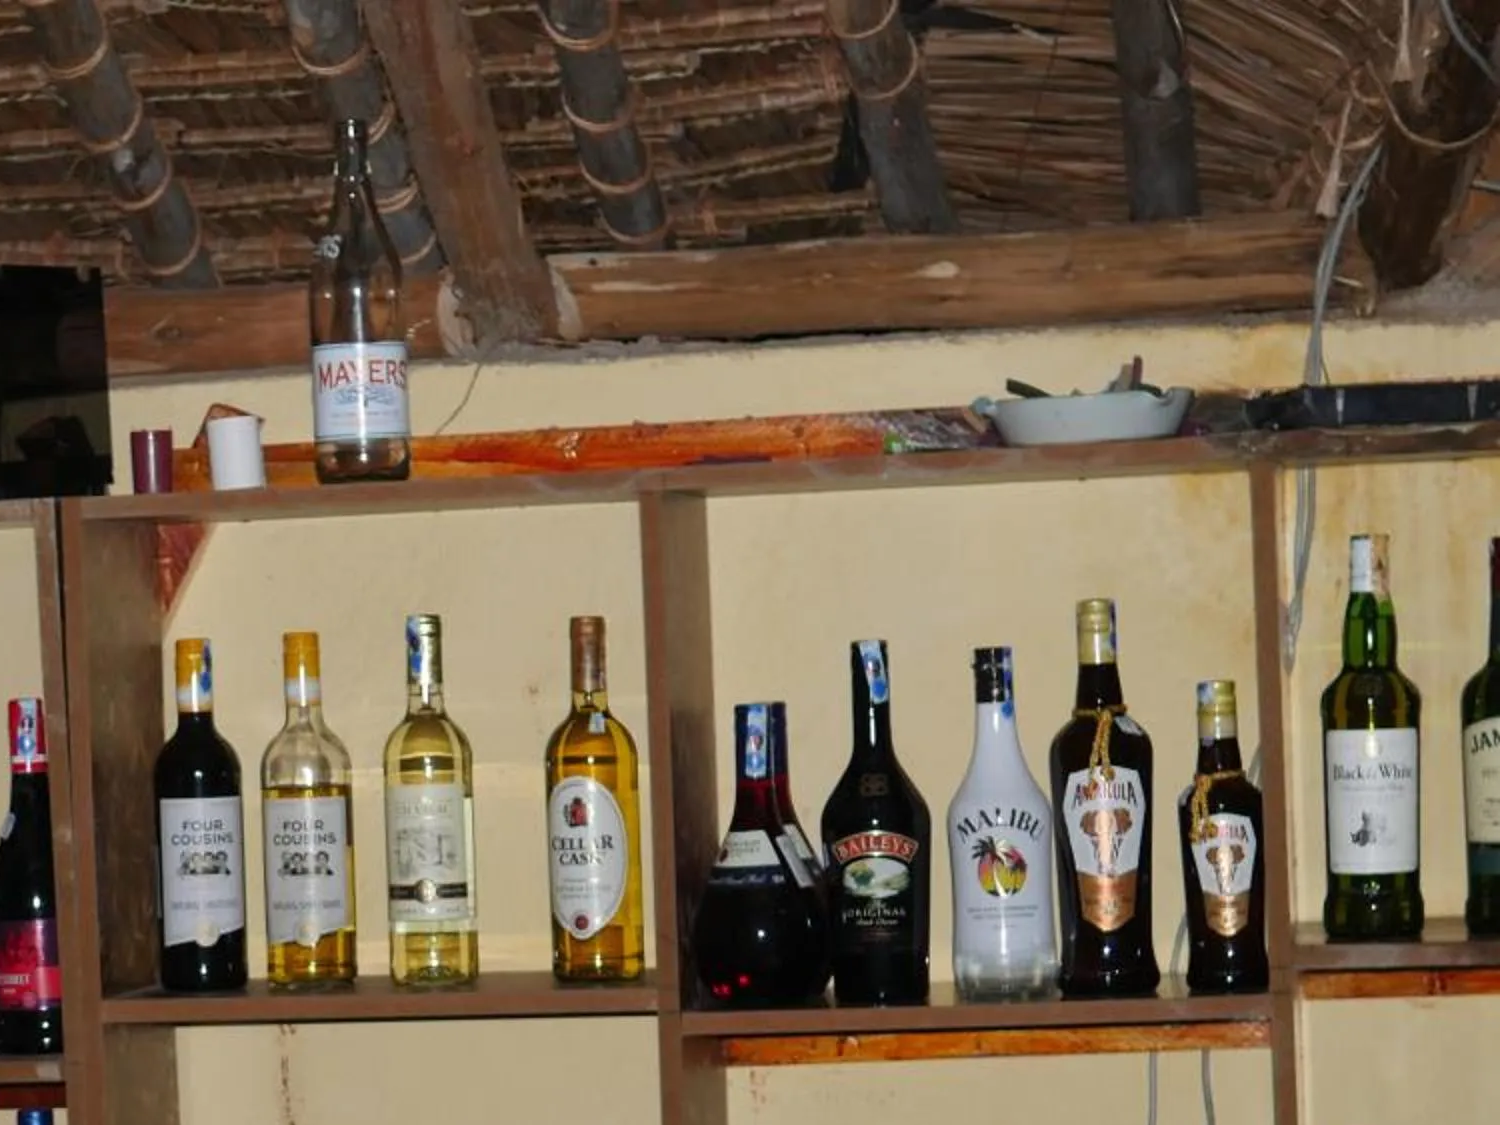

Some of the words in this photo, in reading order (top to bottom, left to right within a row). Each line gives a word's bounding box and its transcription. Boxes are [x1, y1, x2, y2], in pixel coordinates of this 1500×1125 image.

[1333, 763, 1363, 781] Black
[182, 819, 223, 832] FOUR
[283, 819, 324, 832] FOUR
[956, 808, 1041, 844] MALIBU
[171, 832, 233, 846] COUSINS
[837, 836, 913, 858] BAILEYS
